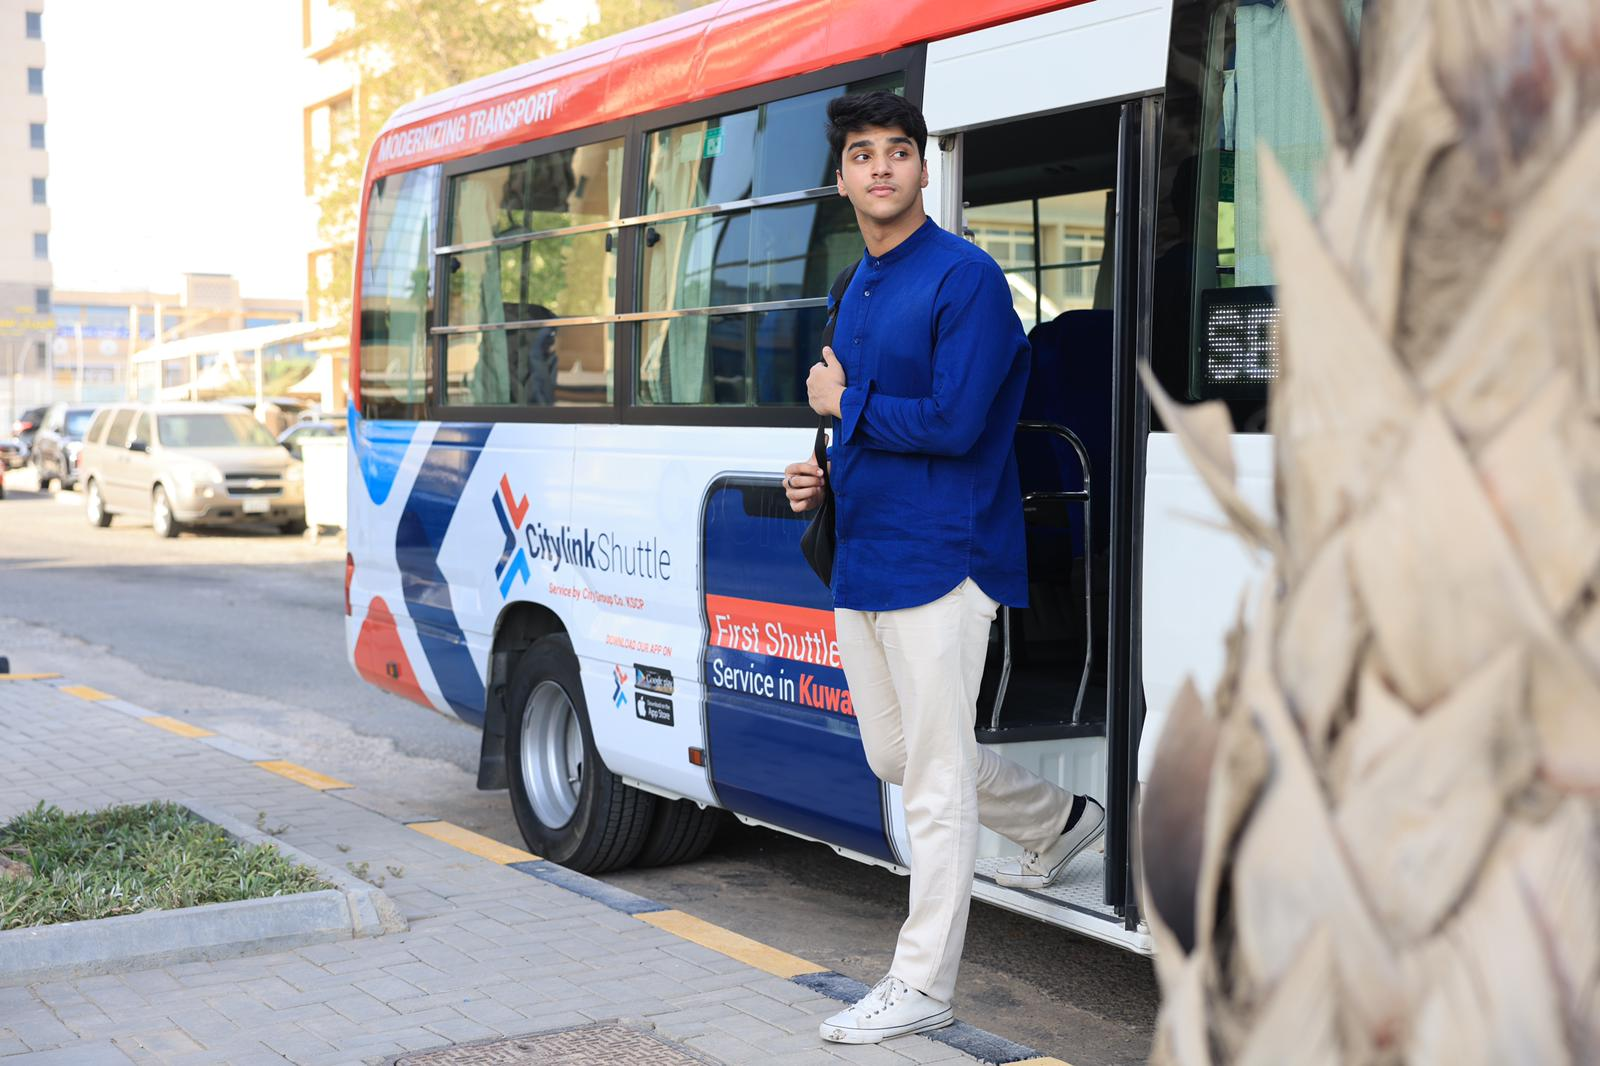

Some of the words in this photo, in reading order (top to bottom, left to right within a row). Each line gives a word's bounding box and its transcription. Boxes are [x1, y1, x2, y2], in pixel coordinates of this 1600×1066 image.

[378, 116, 465, 162] MODERNIZING
[468, 89, 558, 139] TRANSPORT
[549, 582, 571, 597] Service
[572, 586, 581, 600] by
[637, 641, 650, 653] OUR
[651, 644, 662, 655] APP
[663, 646, 672, 657] ON
[715, 614, 760, 653] First
[765, 622, 840, 668] Shuttle
[713, 658, 774, 697] Service
[779, 668, 795, 702] in
[800, 673, 856, 715] Kuwa
[648, 707, 658, 719] App
[658, 709, 671, 720] Store
